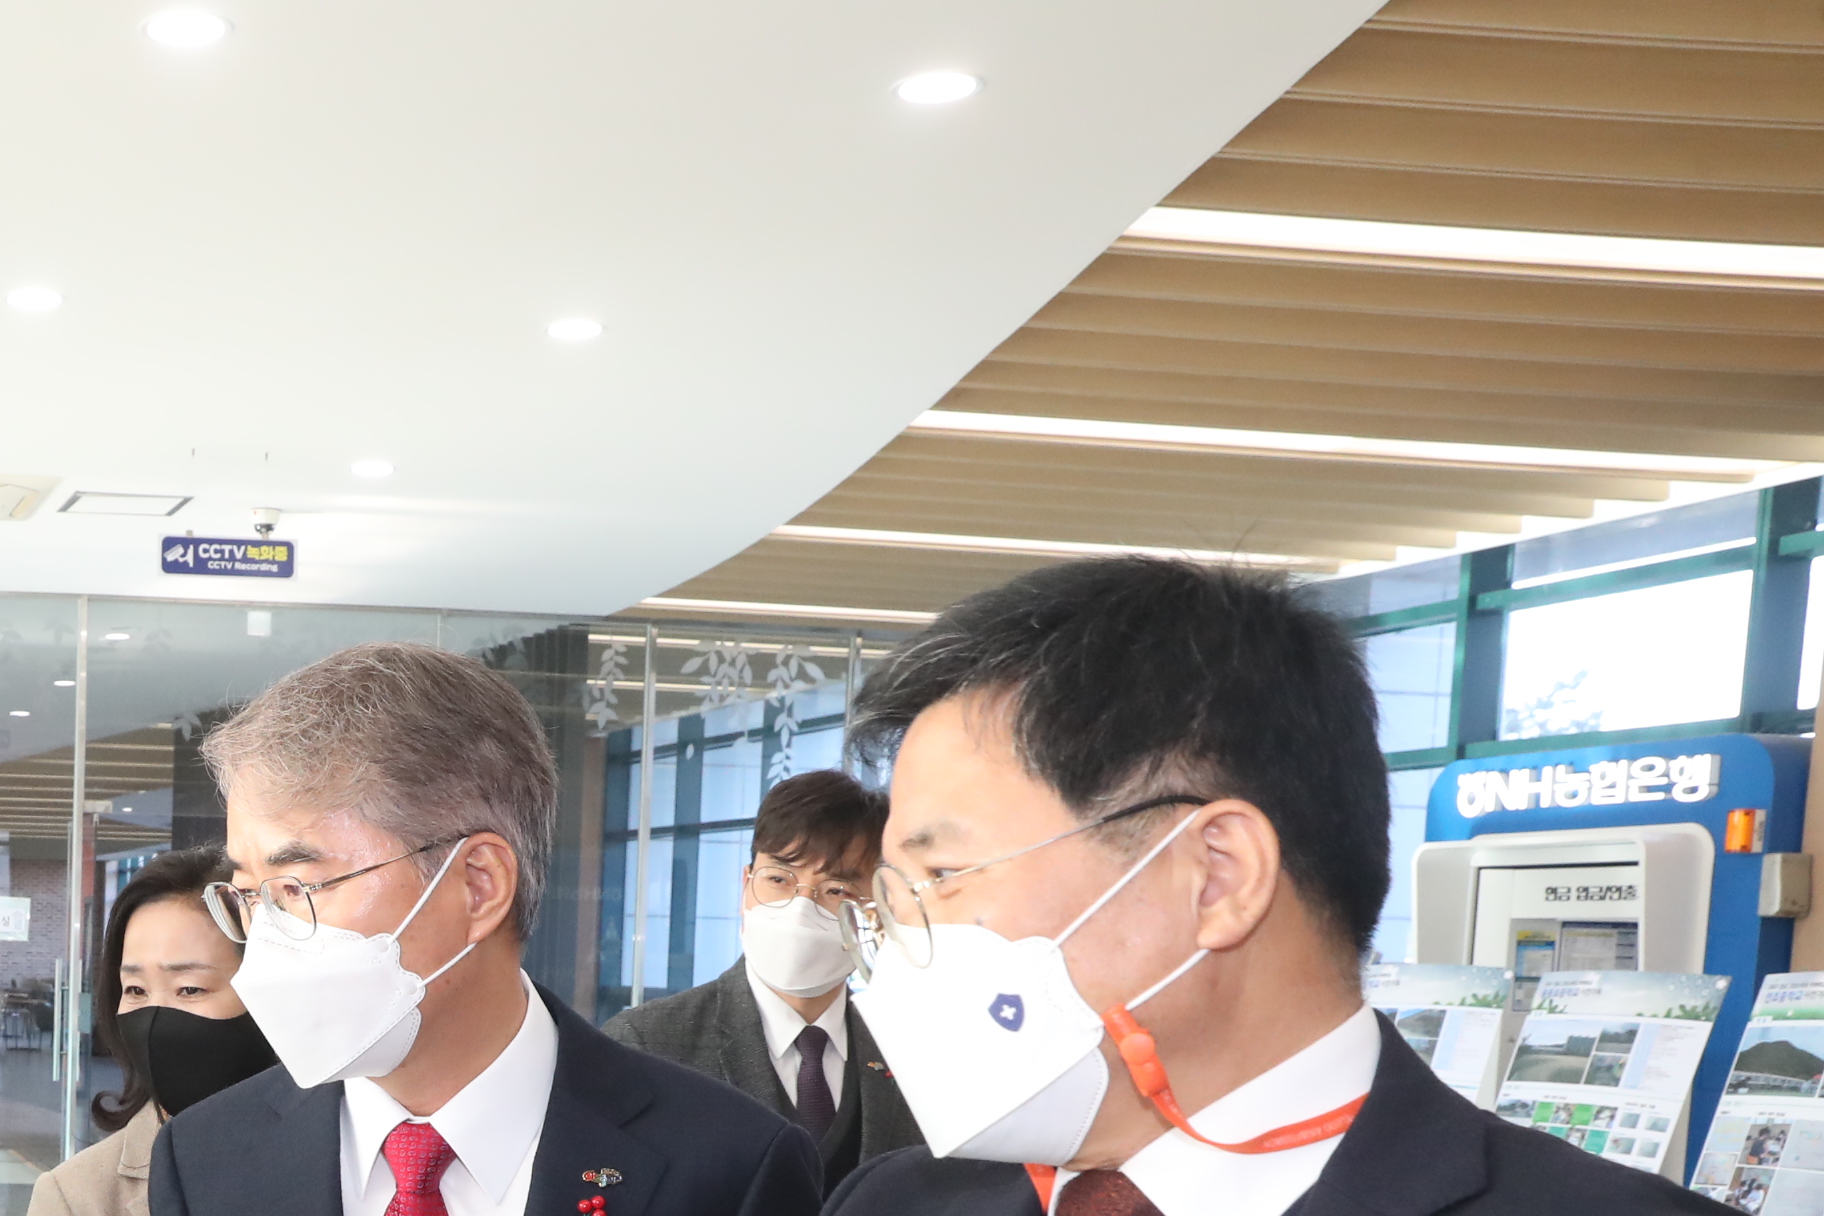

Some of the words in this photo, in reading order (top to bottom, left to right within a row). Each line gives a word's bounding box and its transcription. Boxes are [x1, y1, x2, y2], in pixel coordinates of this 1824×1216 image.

[198, 543, 246, 559] CCTV
[207, 560, 233, 570] CCTV
[234, 561, 278, 573] Recording
